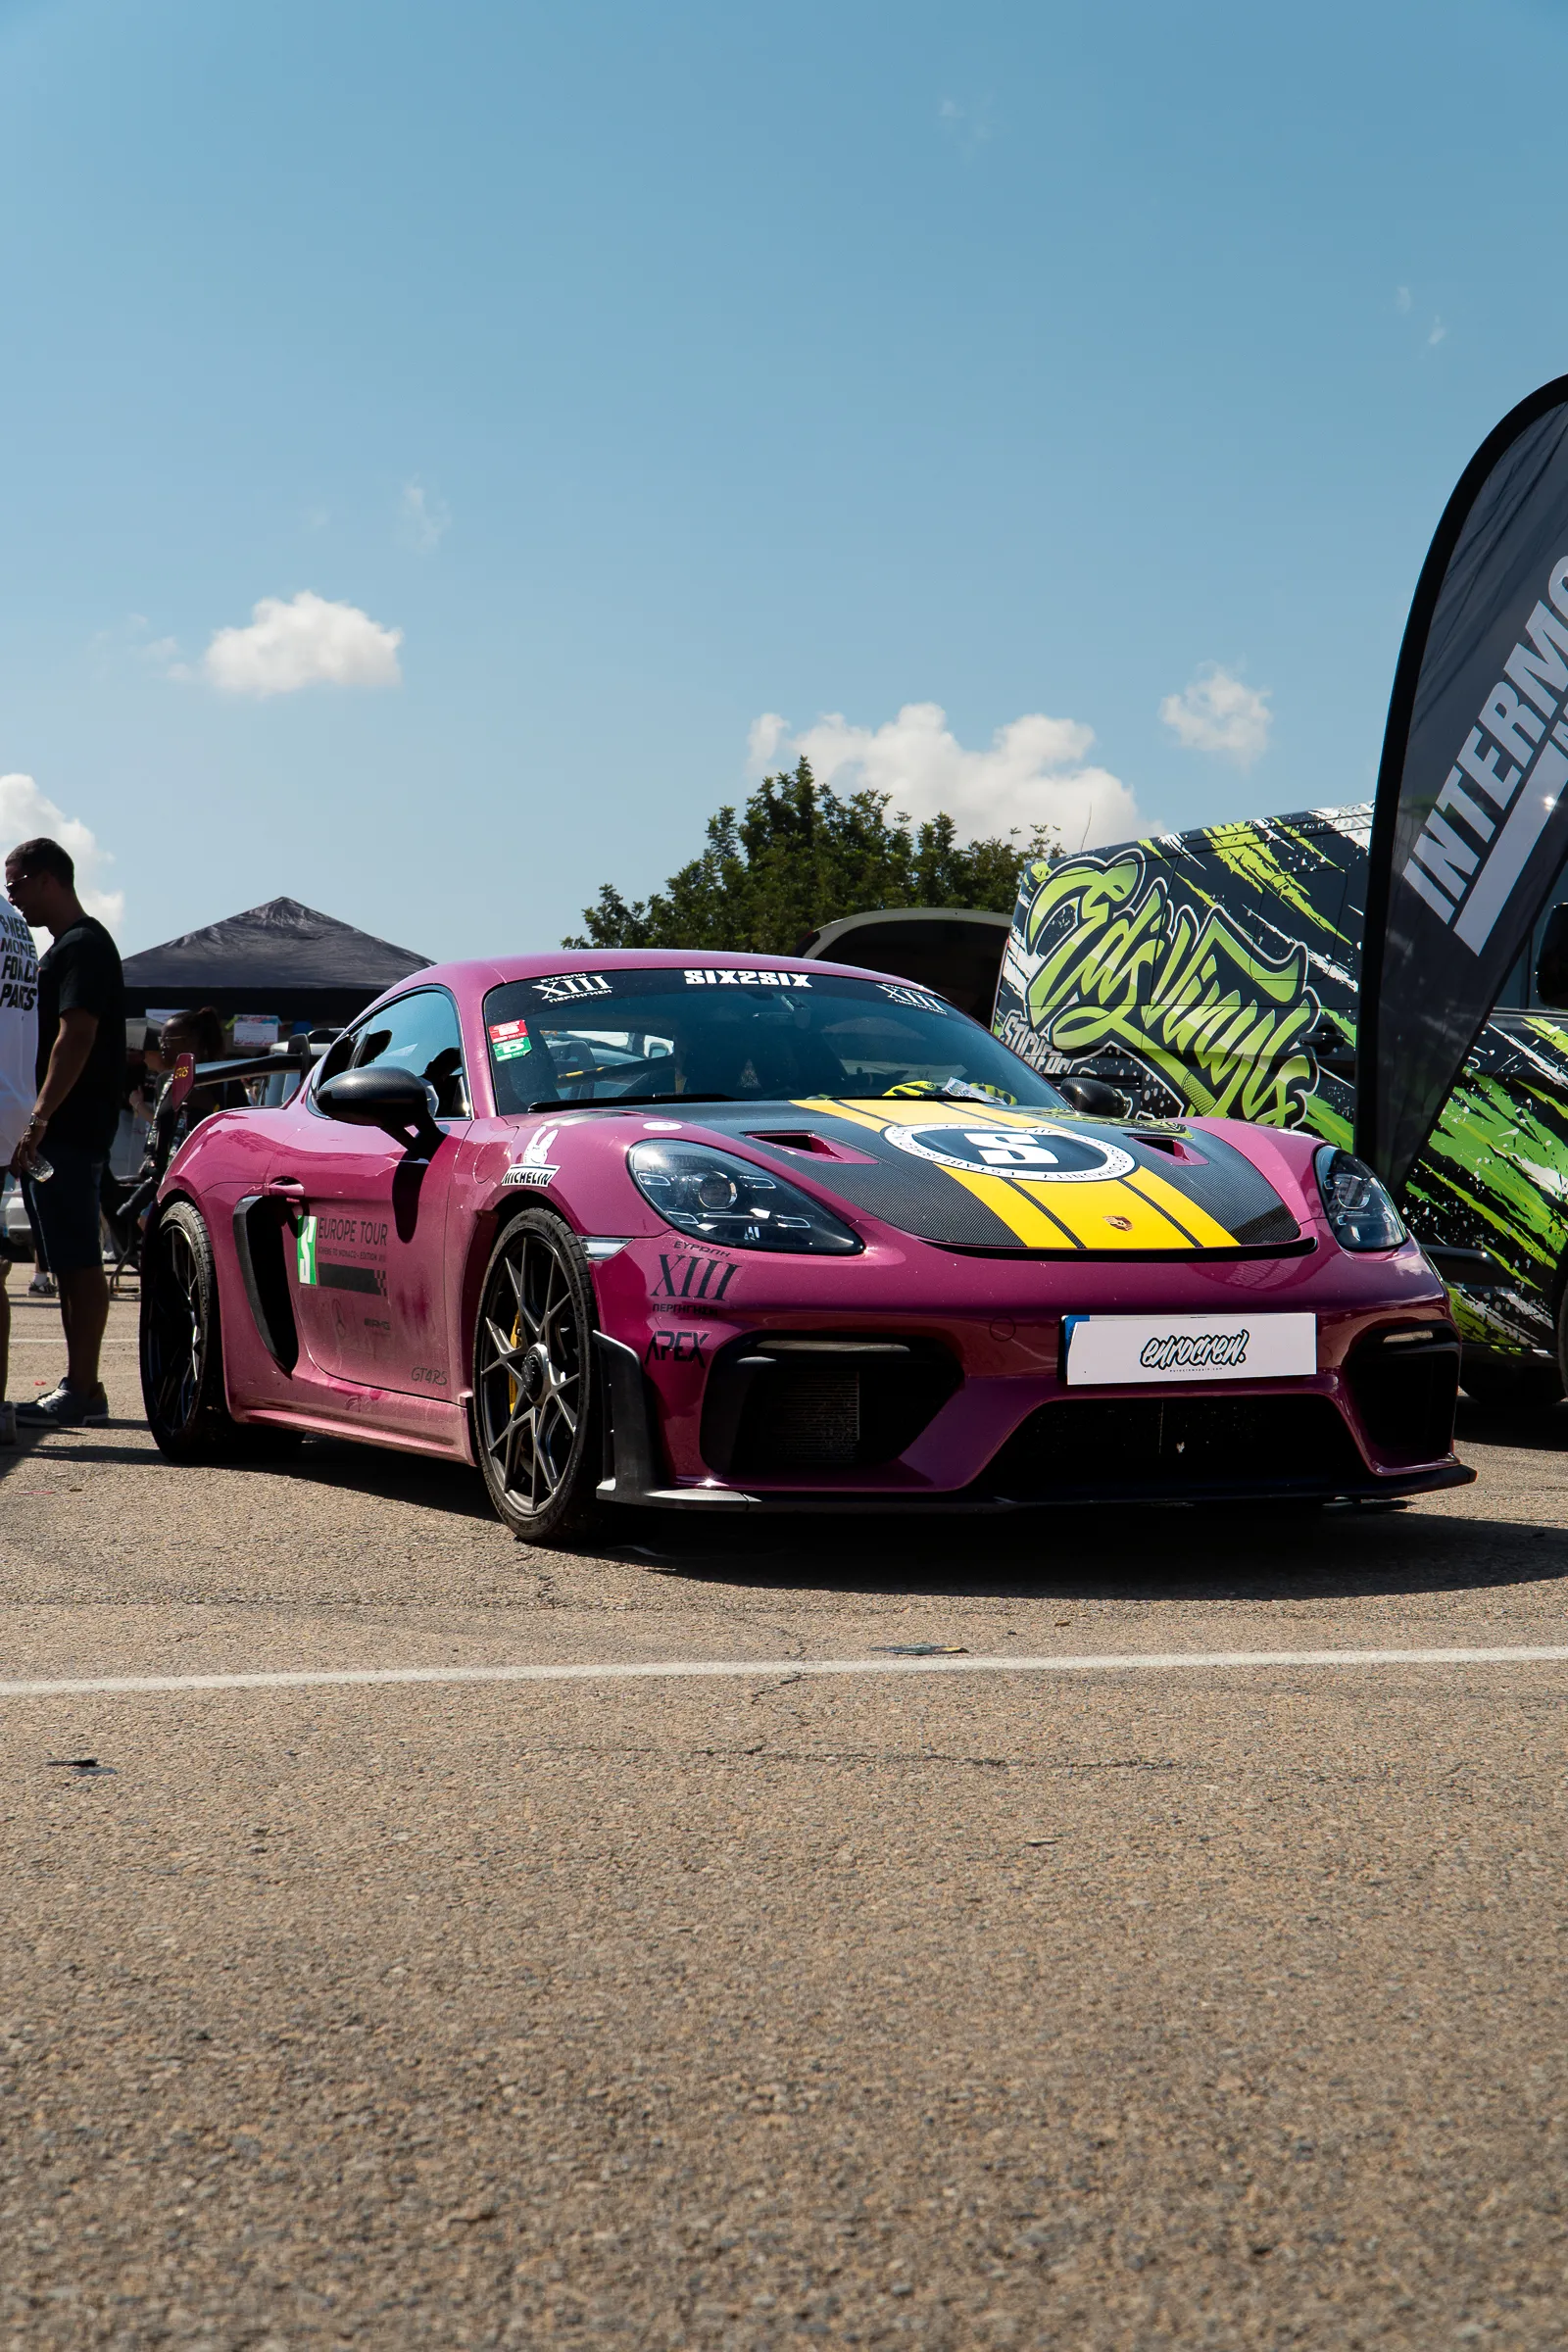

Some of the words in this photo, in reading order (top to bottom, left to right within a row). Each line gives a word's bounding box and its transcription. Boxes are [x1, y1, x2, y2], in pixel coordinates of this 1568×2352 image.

[0, 938, 37, 959] MONE
[531, 975, 613, 1001] XIII
[683, 969, 813, 988] SIX2SIX
[963, 1132, 1059, 1164] S
[502, 1170, 554, 1187] MICHELIN
[318, 1217, 357, 1243] EUROPE
[360, 1221, 388, 1247] TOUR
[650, 1254, 743, 1301] XIII
[644, 1330, 710, 1369] APEX
[412, 1366, 448, 1386] GT4RS
